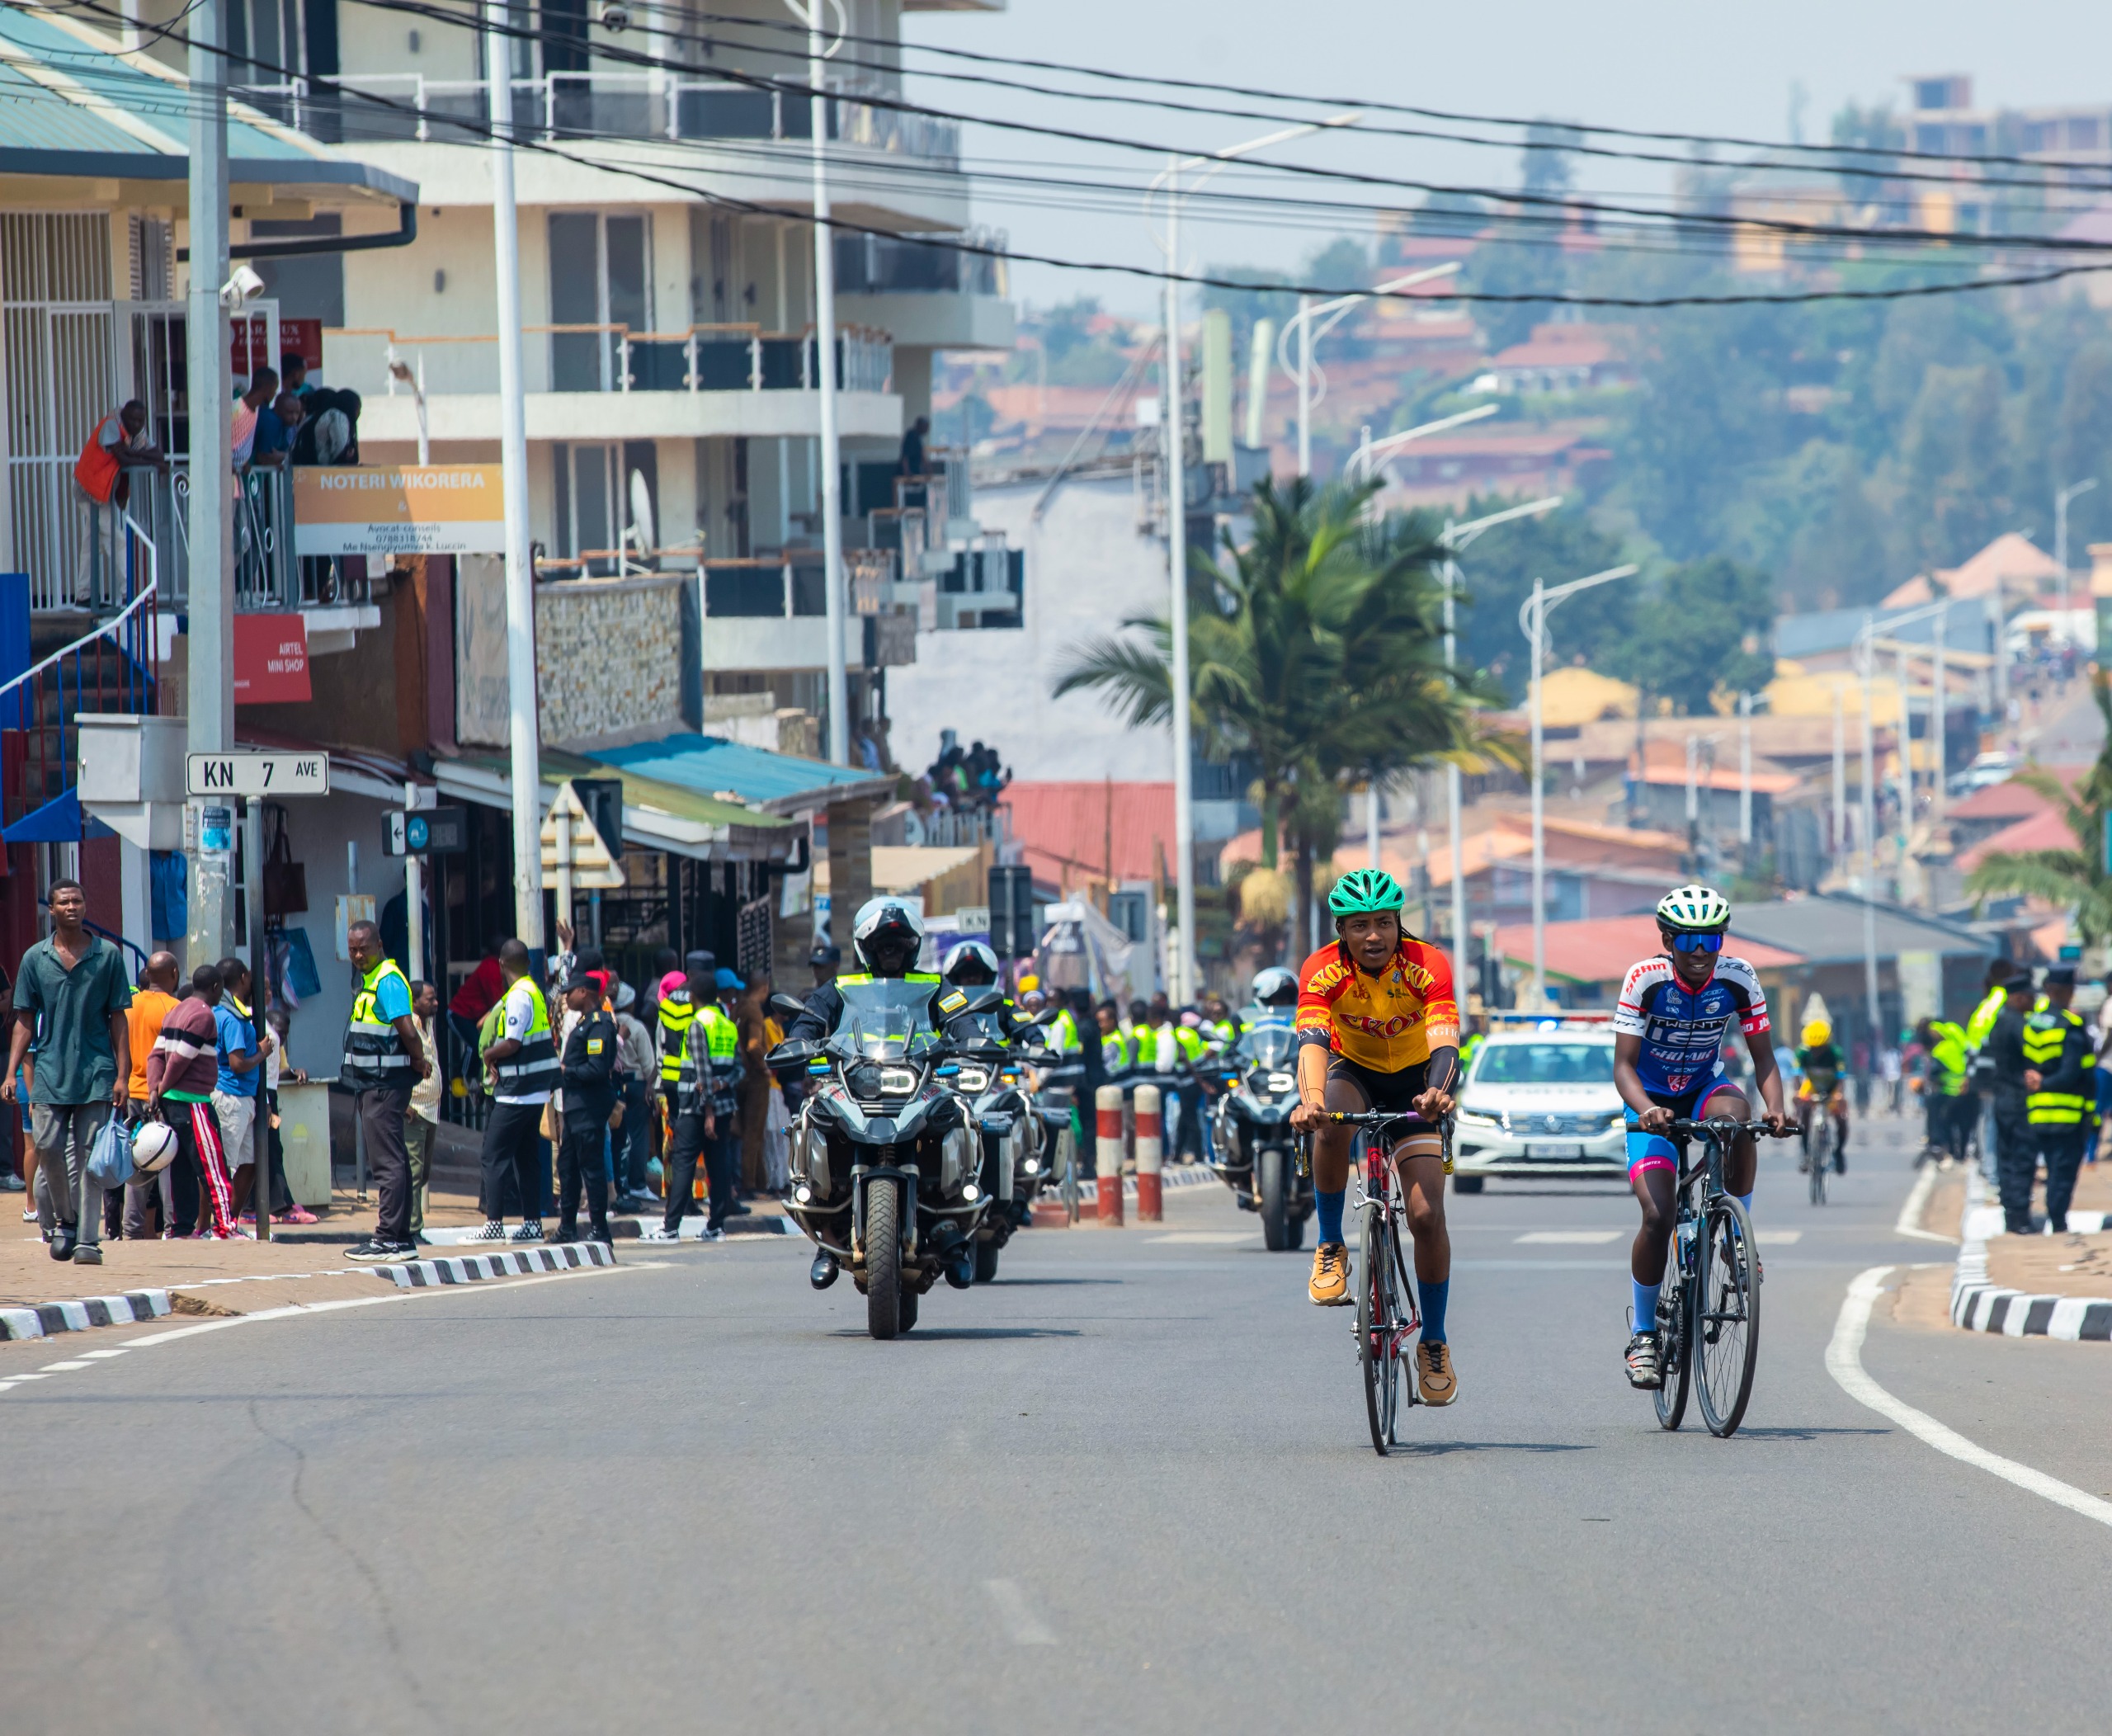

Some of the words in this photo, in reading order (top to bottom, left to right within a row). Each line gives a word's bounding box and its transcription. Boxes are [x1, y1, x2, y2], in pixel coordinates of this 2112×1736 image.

[320, 474, 385, 489] NOTERI
[389, 472, 485, 489] WIKORERA
[279, 641, 304, 656] AIRTEL
[267, 659, 284, 673] MINI
[285, 658, 304, 673] SHOP
[204, 762, 233, 787] KN
[262, 762, 274, 787] 7
[295, 761, 318, 777] AVE
[1307, 959, 1352, 997] SKOL
[1652, 1014, 1729, 1031] TWENTY
